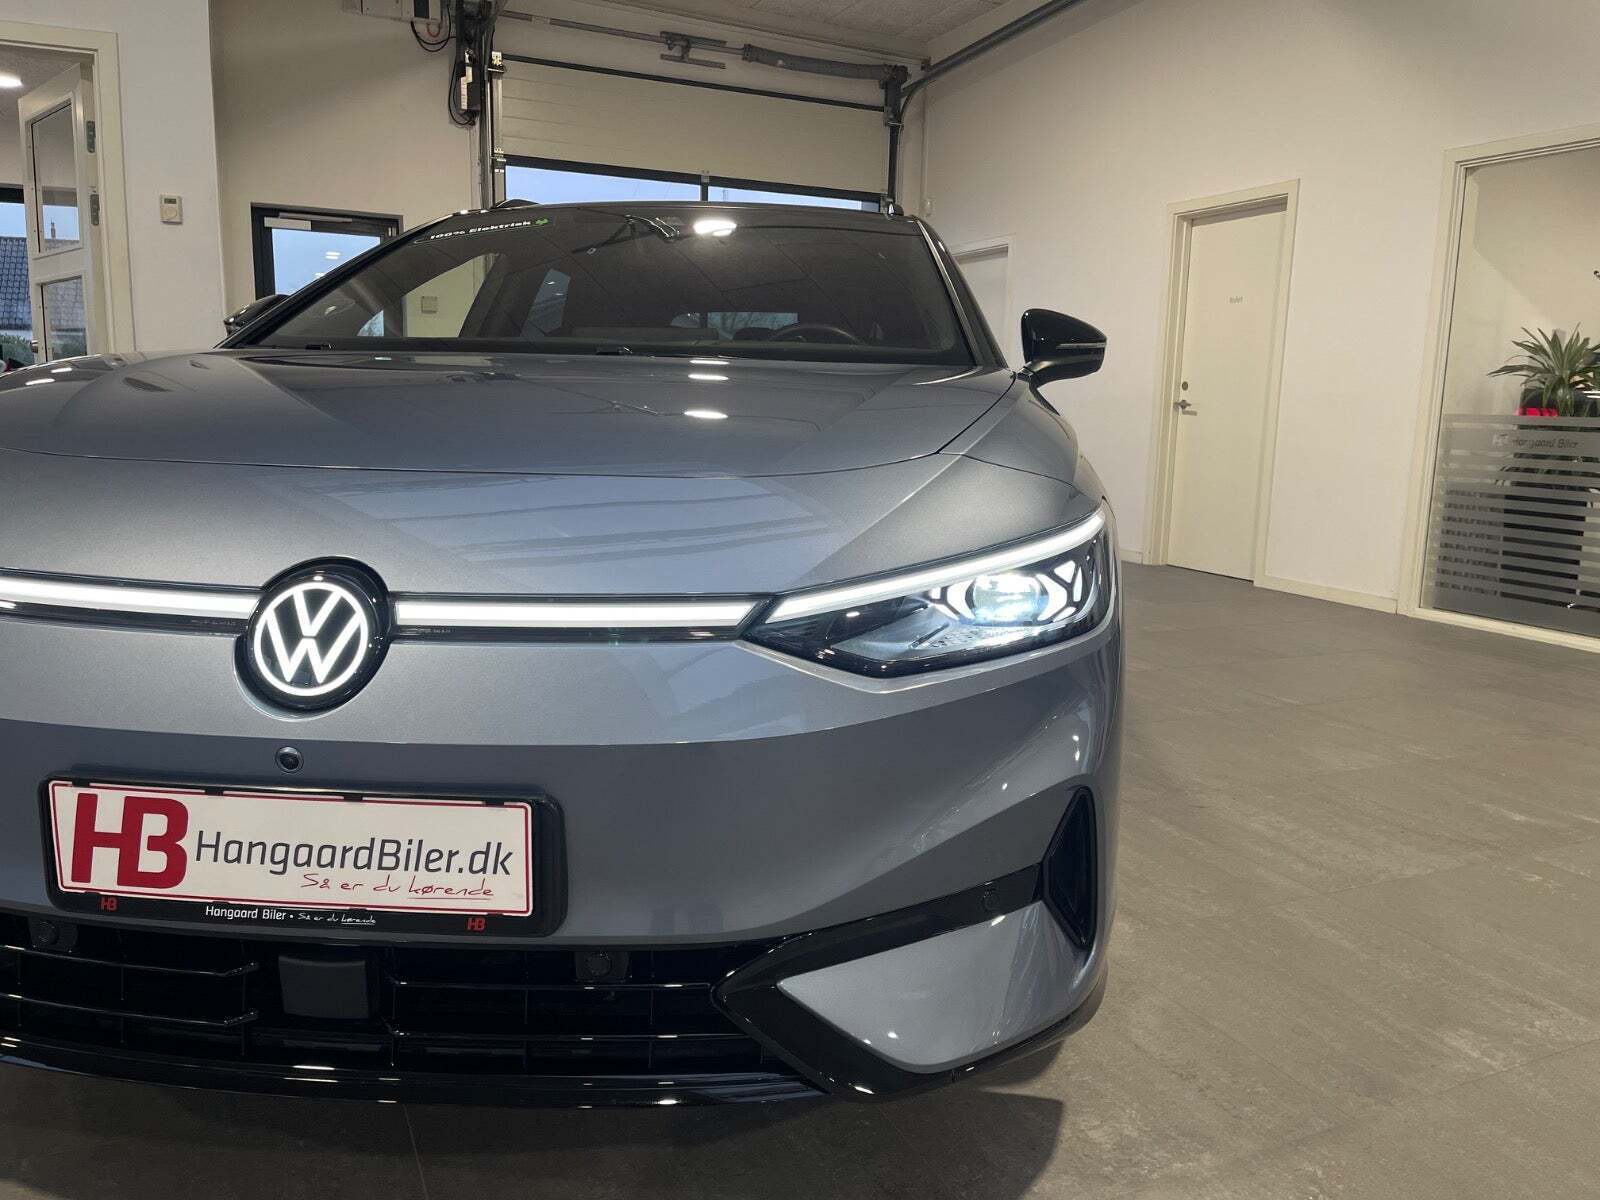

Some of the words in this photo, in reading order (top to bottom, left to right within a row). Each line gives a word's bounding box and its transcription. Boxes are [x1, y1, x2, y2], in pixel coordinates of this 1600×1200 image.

[71, 793, 189, 889] HB
[195, 830, 513, 876] HangaardBiler.dk
[300, 873, 330, 889] Så
[340, 881, 364, 891] er
[373, 874, 400, 894] du
[407, 875, 494, 897] kørende
[101, 896, 118, 911] HB
[205, 905, 259, 920] Hangaard
[262, 908, 287, 921] Biler
[467, 917, 486, 931] HB
